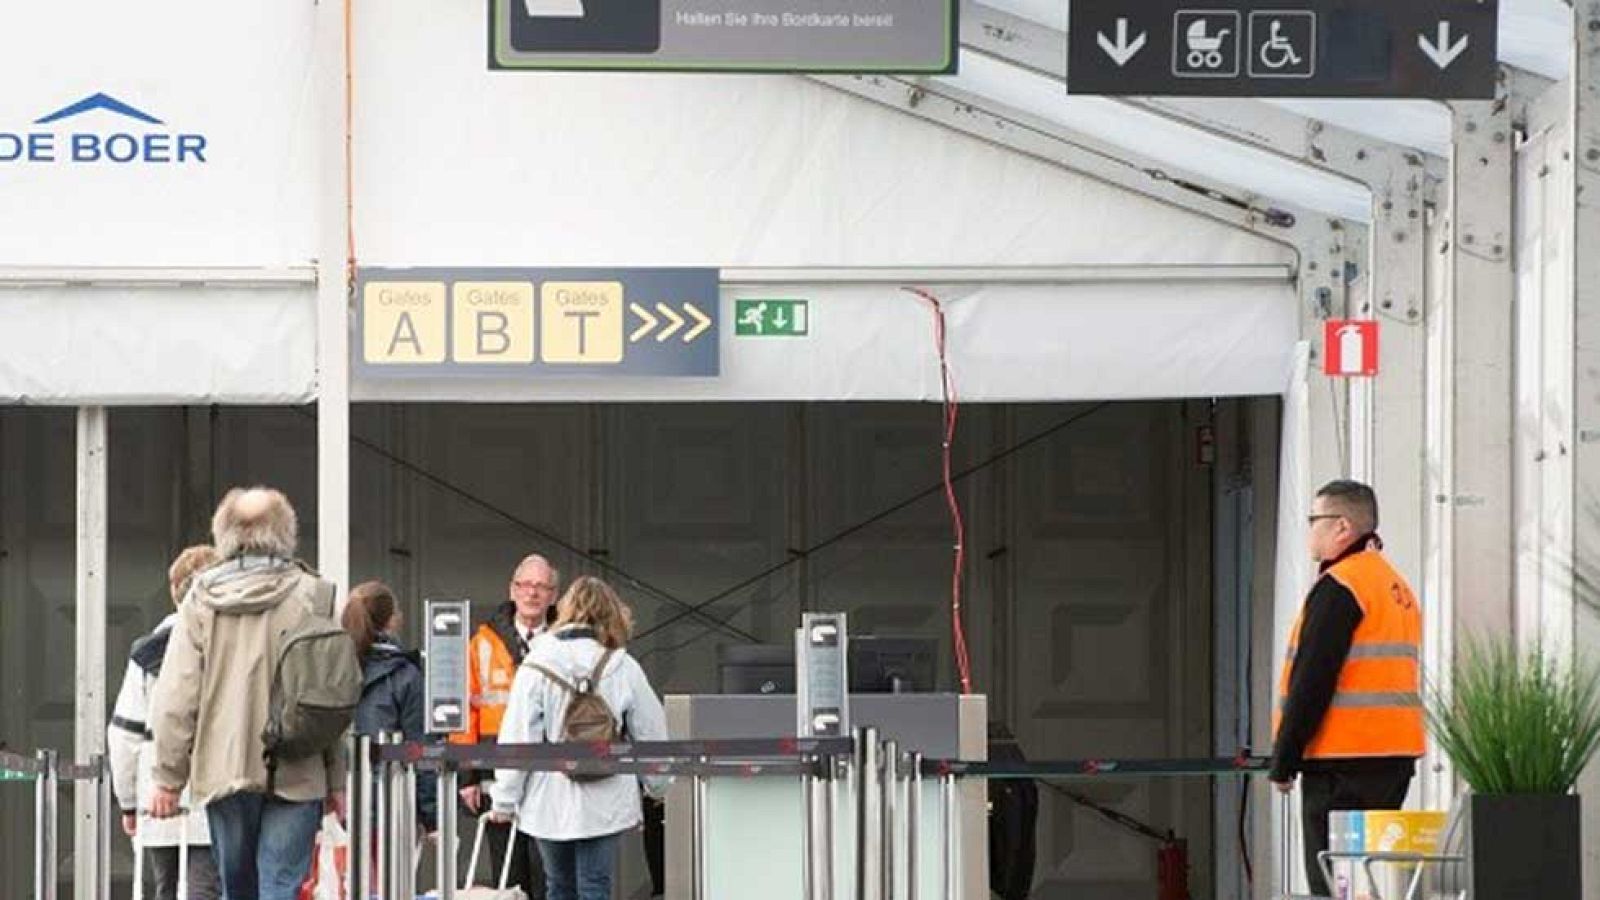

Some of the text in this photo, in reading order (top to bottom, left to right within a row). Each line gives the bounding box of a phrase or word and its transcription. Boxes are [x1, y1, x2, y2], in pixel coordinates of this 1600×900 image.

[724, 12, 748, 27] Sie
[71, 133, 207, 163] BOER
[378, 288, 432, 306] Gates
[467, 288, 520, 306] Gates
[555, 288, 609, 306] Gates
[386, 310, 422, 356] A
[476, 311, 512, 355] B
[563, 311, 601, 355] T
